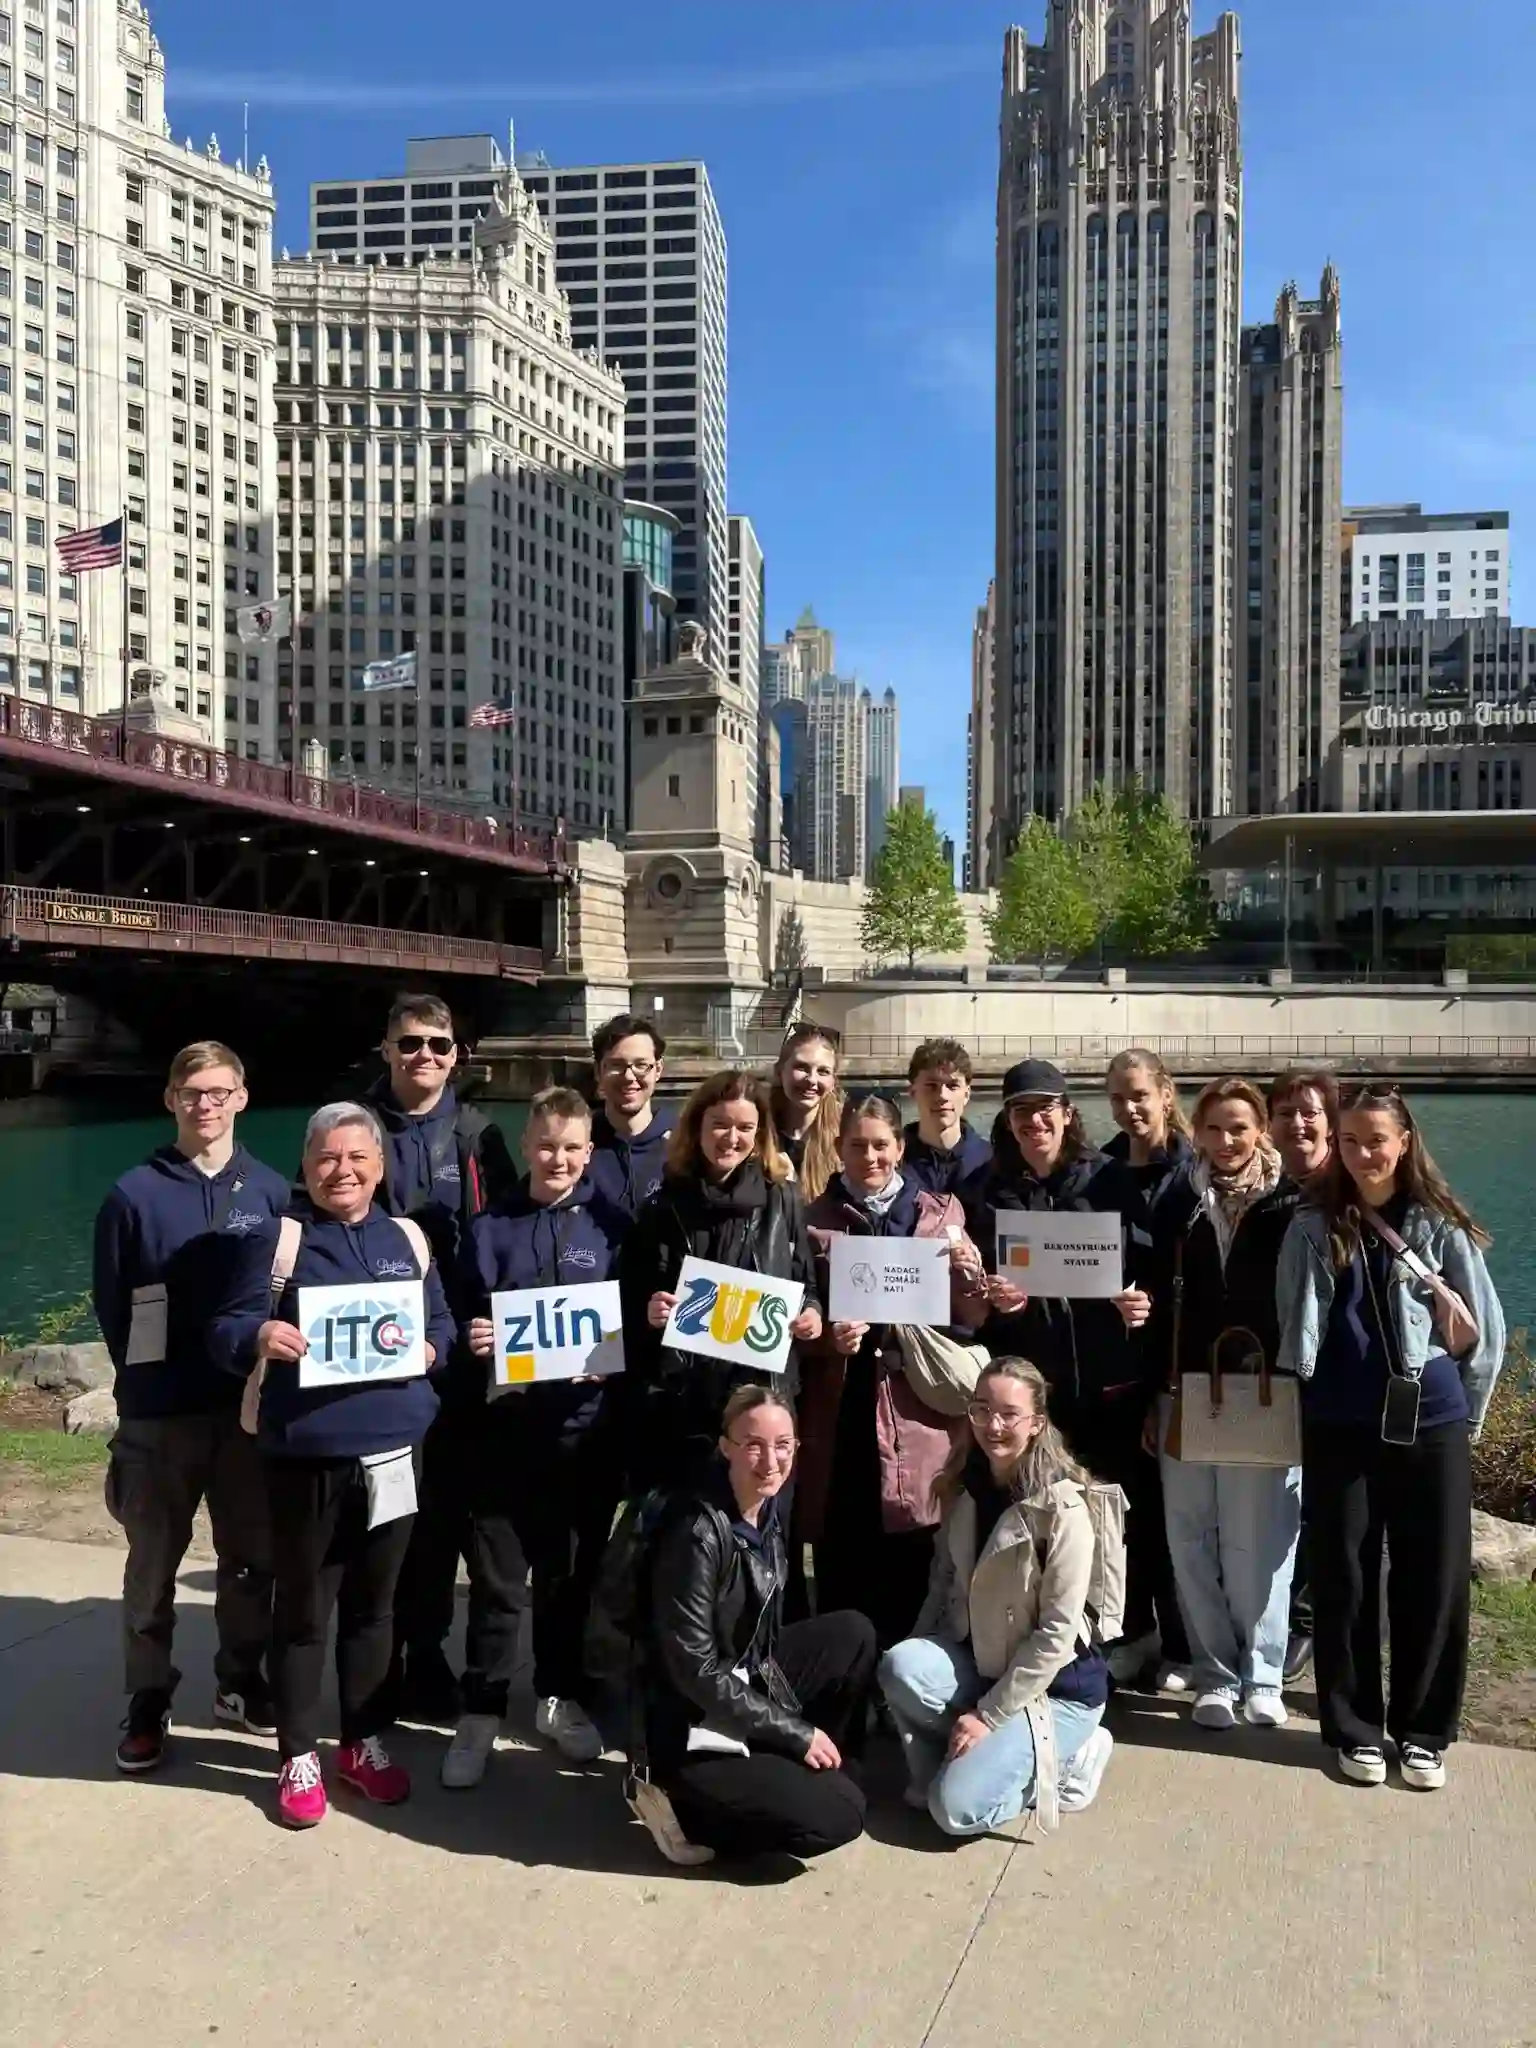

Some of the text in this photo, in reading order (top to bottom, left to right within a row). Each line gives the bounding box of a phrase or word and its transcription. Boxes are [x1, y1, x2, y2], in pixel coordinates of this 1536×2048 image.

[1365, 704, 1462, 731] Chicago
[111, 910, 153, 927] BRIDGE
[884, 1266, 920, 1274] NADACE
[505, 1298, 602, 1353] zlín
